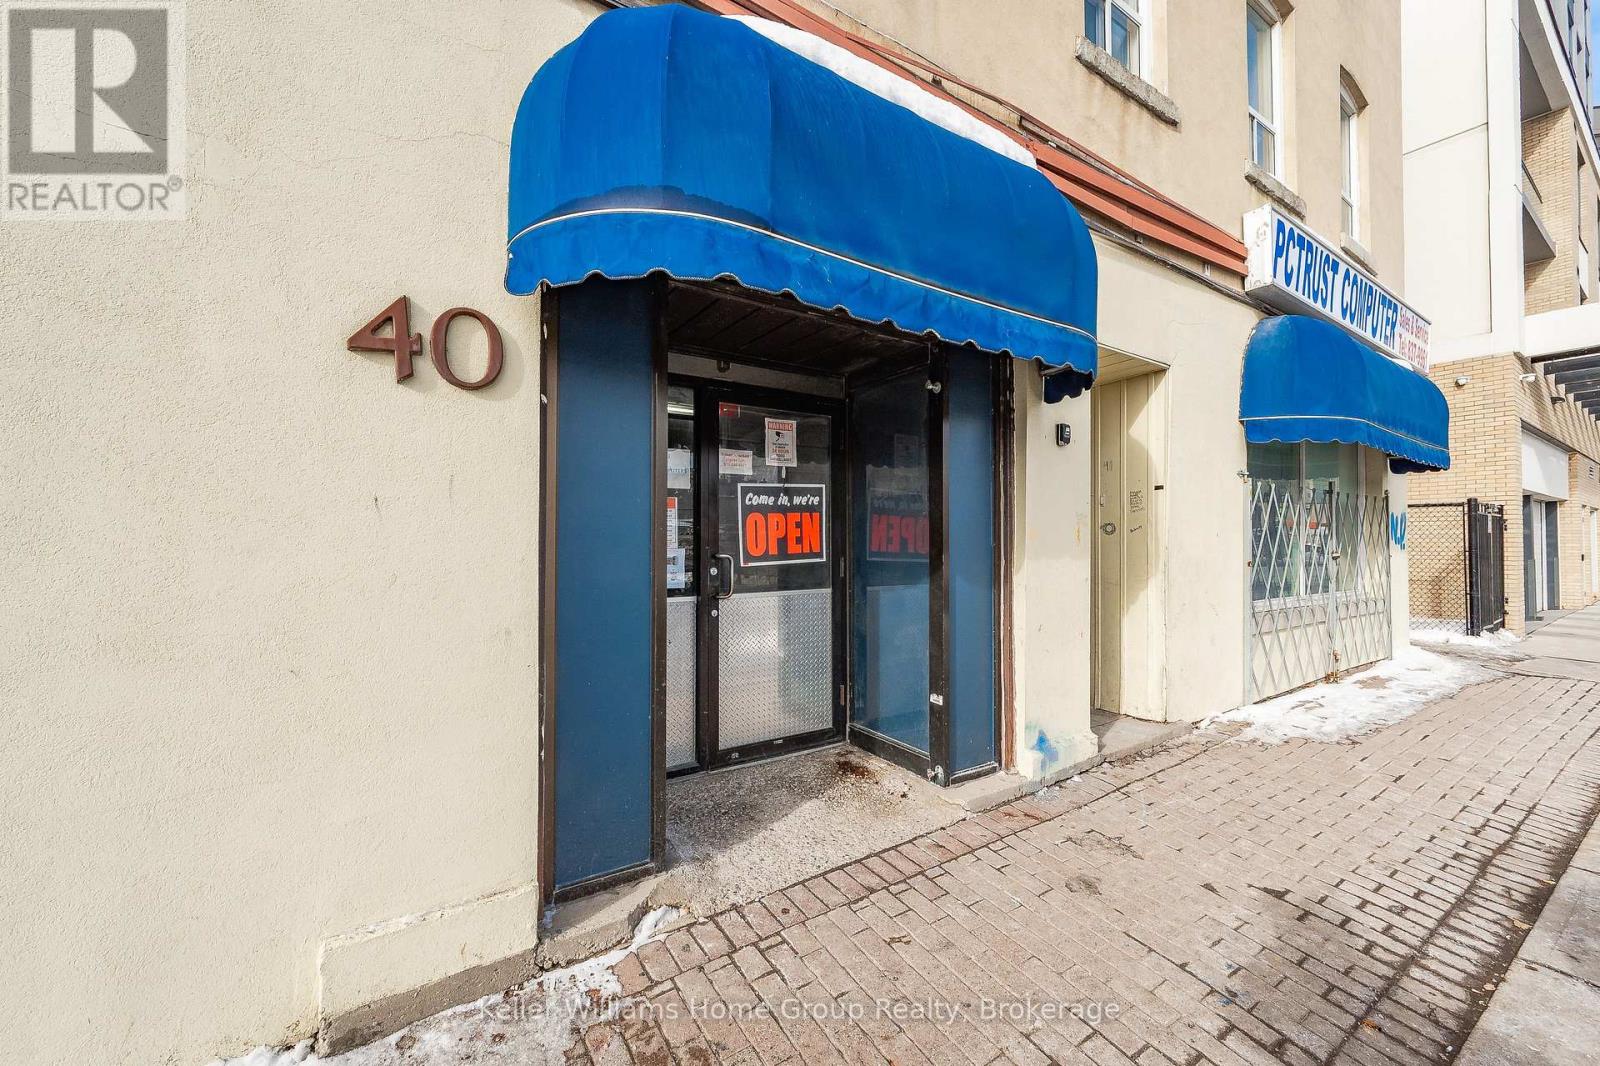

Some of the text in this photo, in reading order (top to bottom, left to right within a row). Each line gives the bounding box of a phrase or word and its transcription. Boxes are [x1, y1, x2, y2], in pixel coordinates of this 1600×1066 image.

[1273, 218, 1399, 350] PCTRUST COMPUTER
[347, 295, 504, 390] 40
[745, 493, 819, 507] Come in, we're
[745, 512, 821, 557] OPEN
